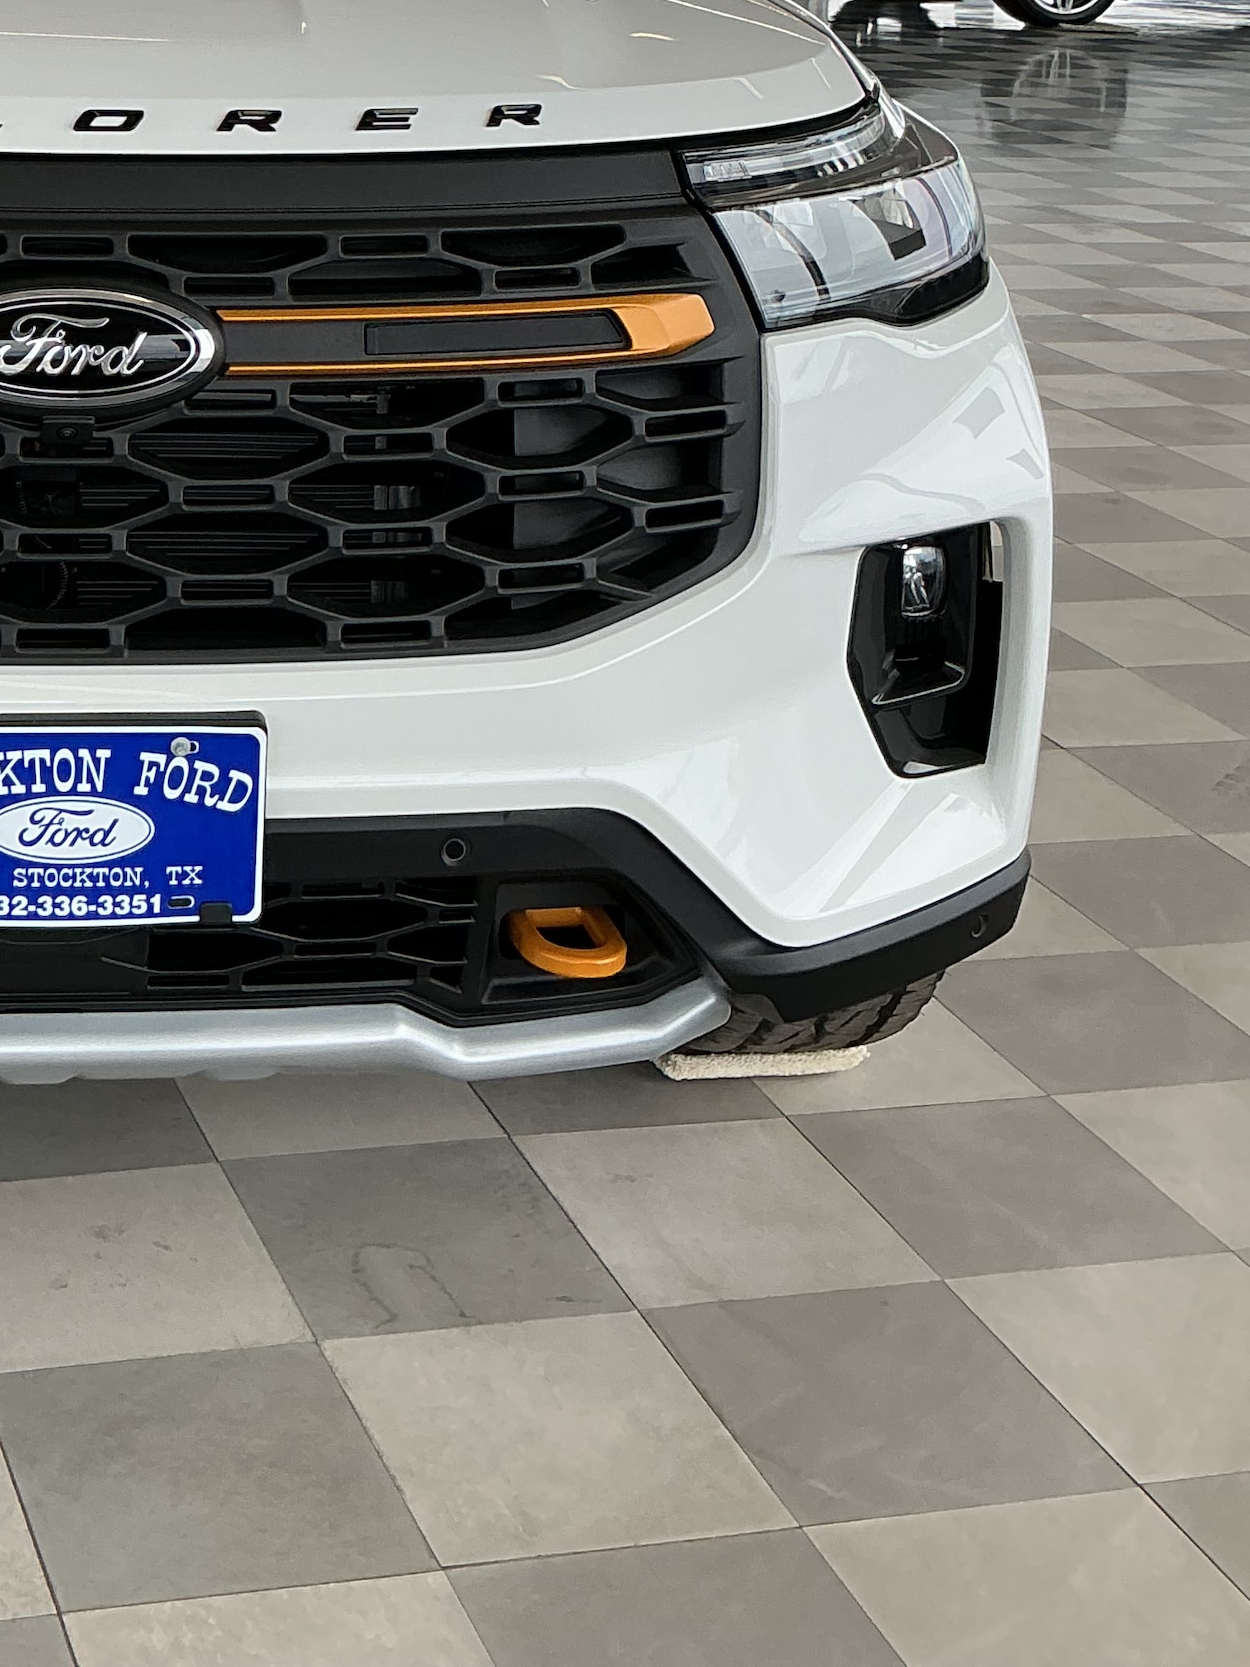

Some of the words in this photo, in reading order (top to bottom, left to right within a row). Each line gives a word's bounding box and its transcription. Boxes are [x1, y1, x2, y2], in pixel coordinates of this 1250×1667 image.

[133, 751, 253, 813] FORD
[17, 807, 120, 848] Ford
[13, 866, 150, 889] STOCKTON,
[166, 865, 203, 886] TX
